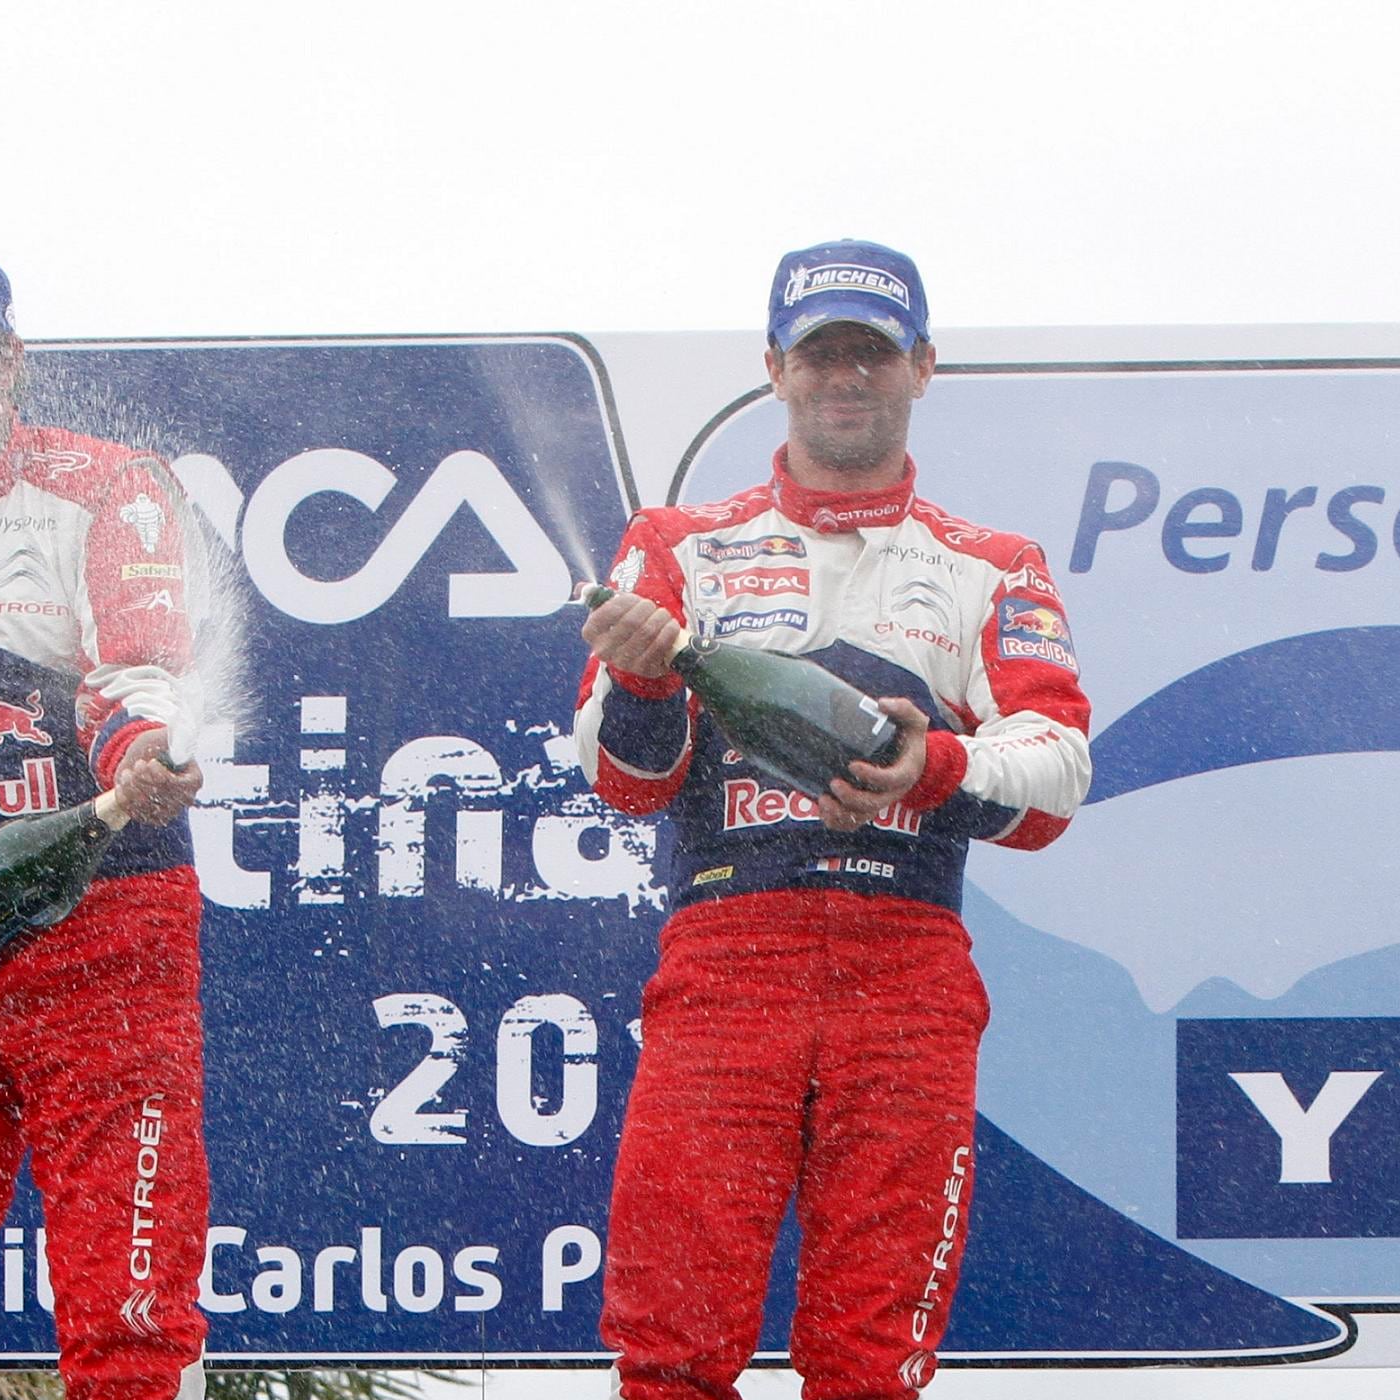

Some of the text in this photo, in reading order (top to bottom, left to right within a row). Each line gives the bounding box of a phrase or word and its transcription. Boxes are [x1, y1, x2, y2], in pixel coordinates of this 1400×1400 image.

[810, 269, 905, 298] MICHELIN
[170, 446, 573, 626] CA
[727, 574, 808, 591] TOTAL
[720, 612, 805, 633] MICHELIN
[844, 857, 895, 879] LOEB
[197, 1225, 503, 1314] Carlos
